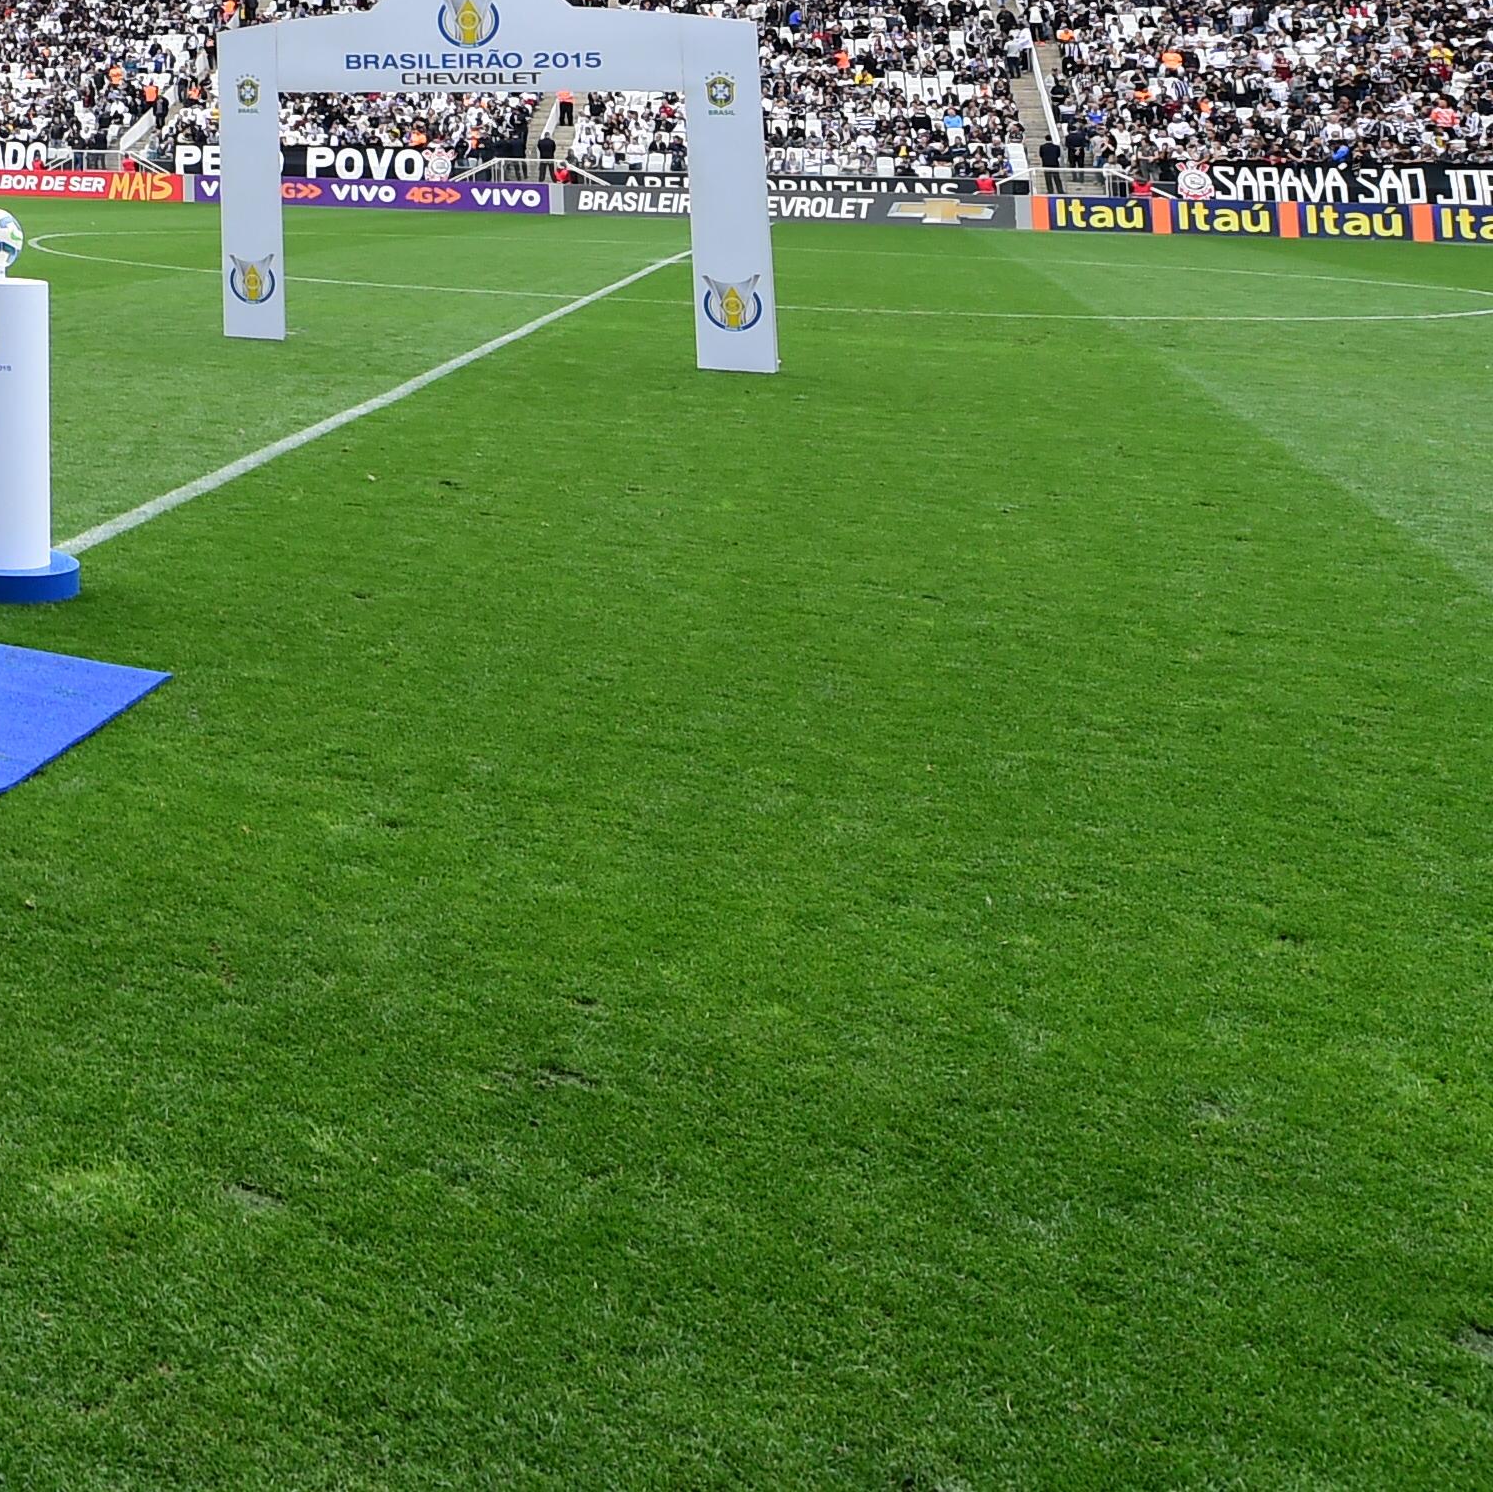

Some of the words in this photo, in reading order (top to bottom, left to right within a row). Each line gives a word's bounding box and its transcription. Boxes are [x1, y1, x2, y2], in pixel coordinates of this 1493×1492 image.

[345, 48, 523, 70] BRASILEIRÃO
[534, 52, 602, 69] 2015
[401, 71, 541, 86] CHEVROLET
[306, 146, 425, 182] POVO
[40, 175, 72, 191] DE
[73, 176, 105, 193] SER
[109, 172, 174, 201] MAIS
[330, 183, 397, 204] VIVO
[470, 187, 542, 208] VIVO
[767, 179, 959, 195] RINTHIANS
[1214, 162, 1350, 204] SARAVÁ
[1356, 164, 1429, 205] SÃO
[578, 188, 692, 215] BRASILEIR
[767, 195, 875, 220] EVROLET
[1055, 198, 1144, 230] Itaú
[1177, 201, 1271, 233] Itaú
[1304, 204, 1404, 237] Itaú
